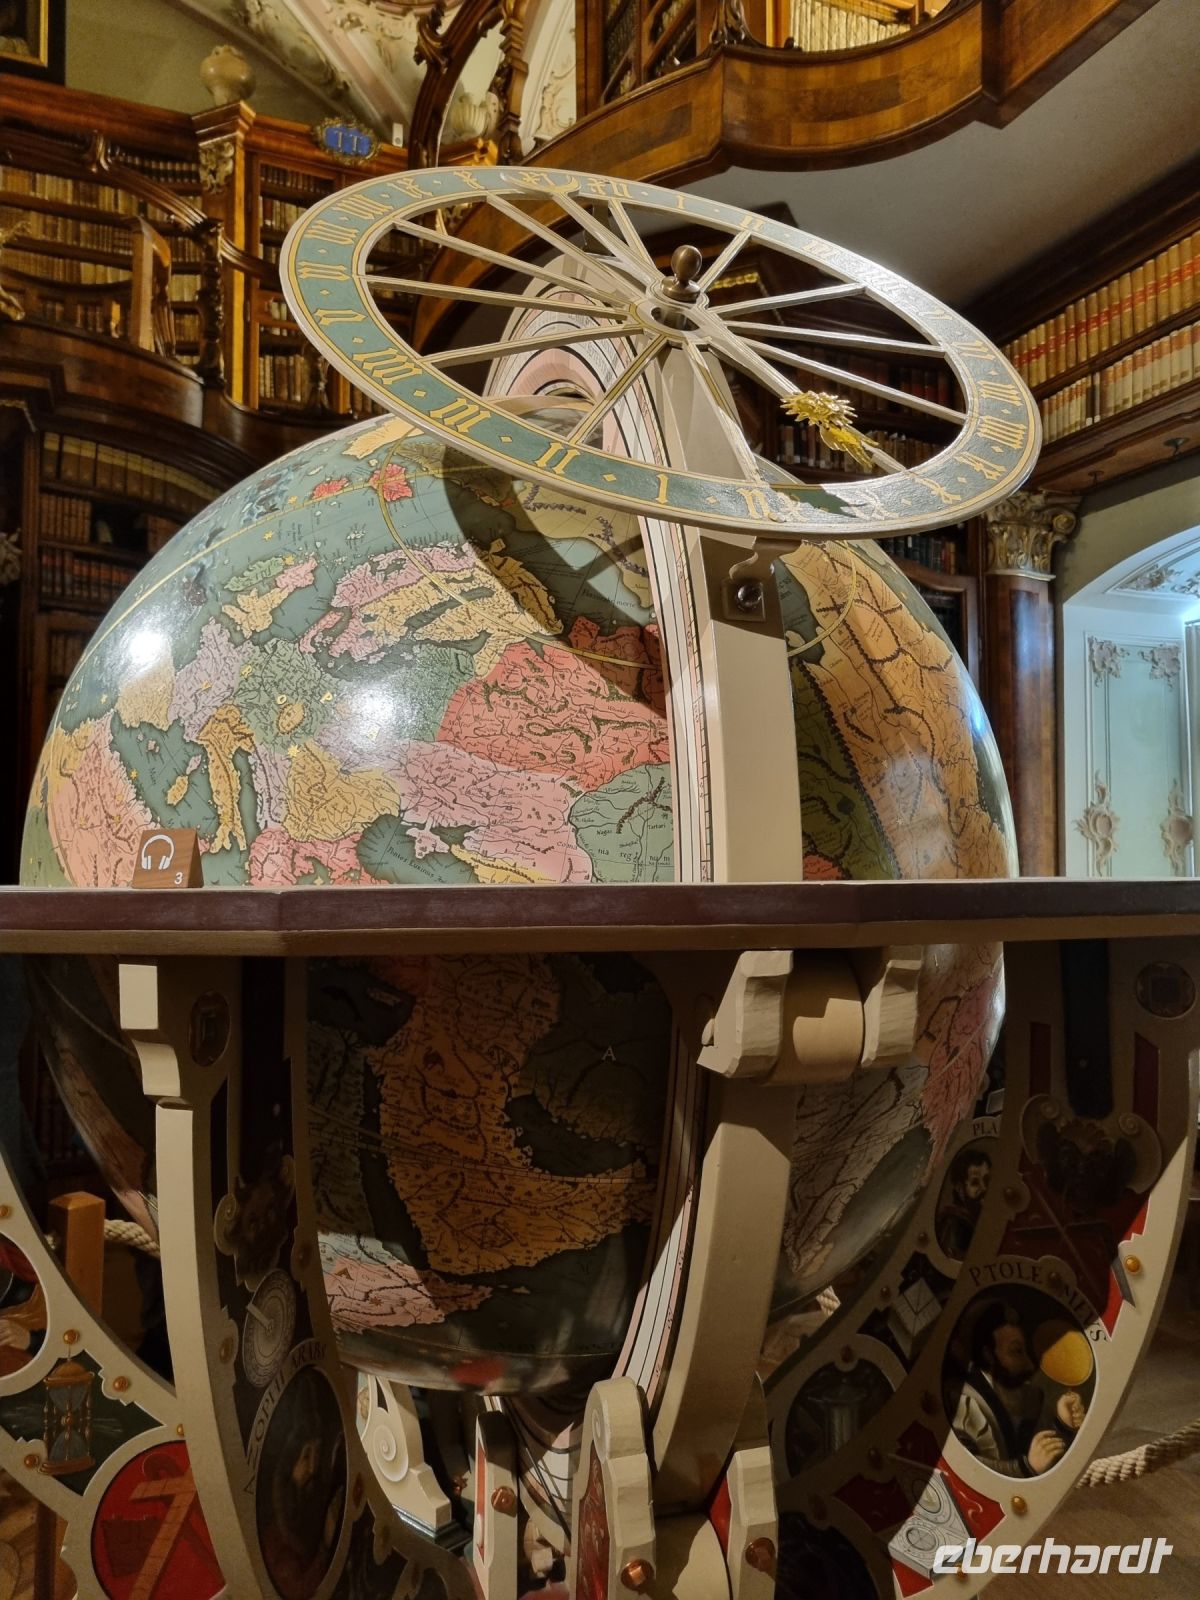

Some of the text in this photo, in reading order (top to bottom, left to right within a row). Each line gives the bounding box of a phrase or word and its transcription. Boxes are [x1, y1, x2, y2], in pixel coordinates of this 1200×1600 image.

[676, 194, 686, 210] I
[534, 441, 581, 475] II
[655, 473, 670, 505] I
[174, 871, 184, 885] 3
